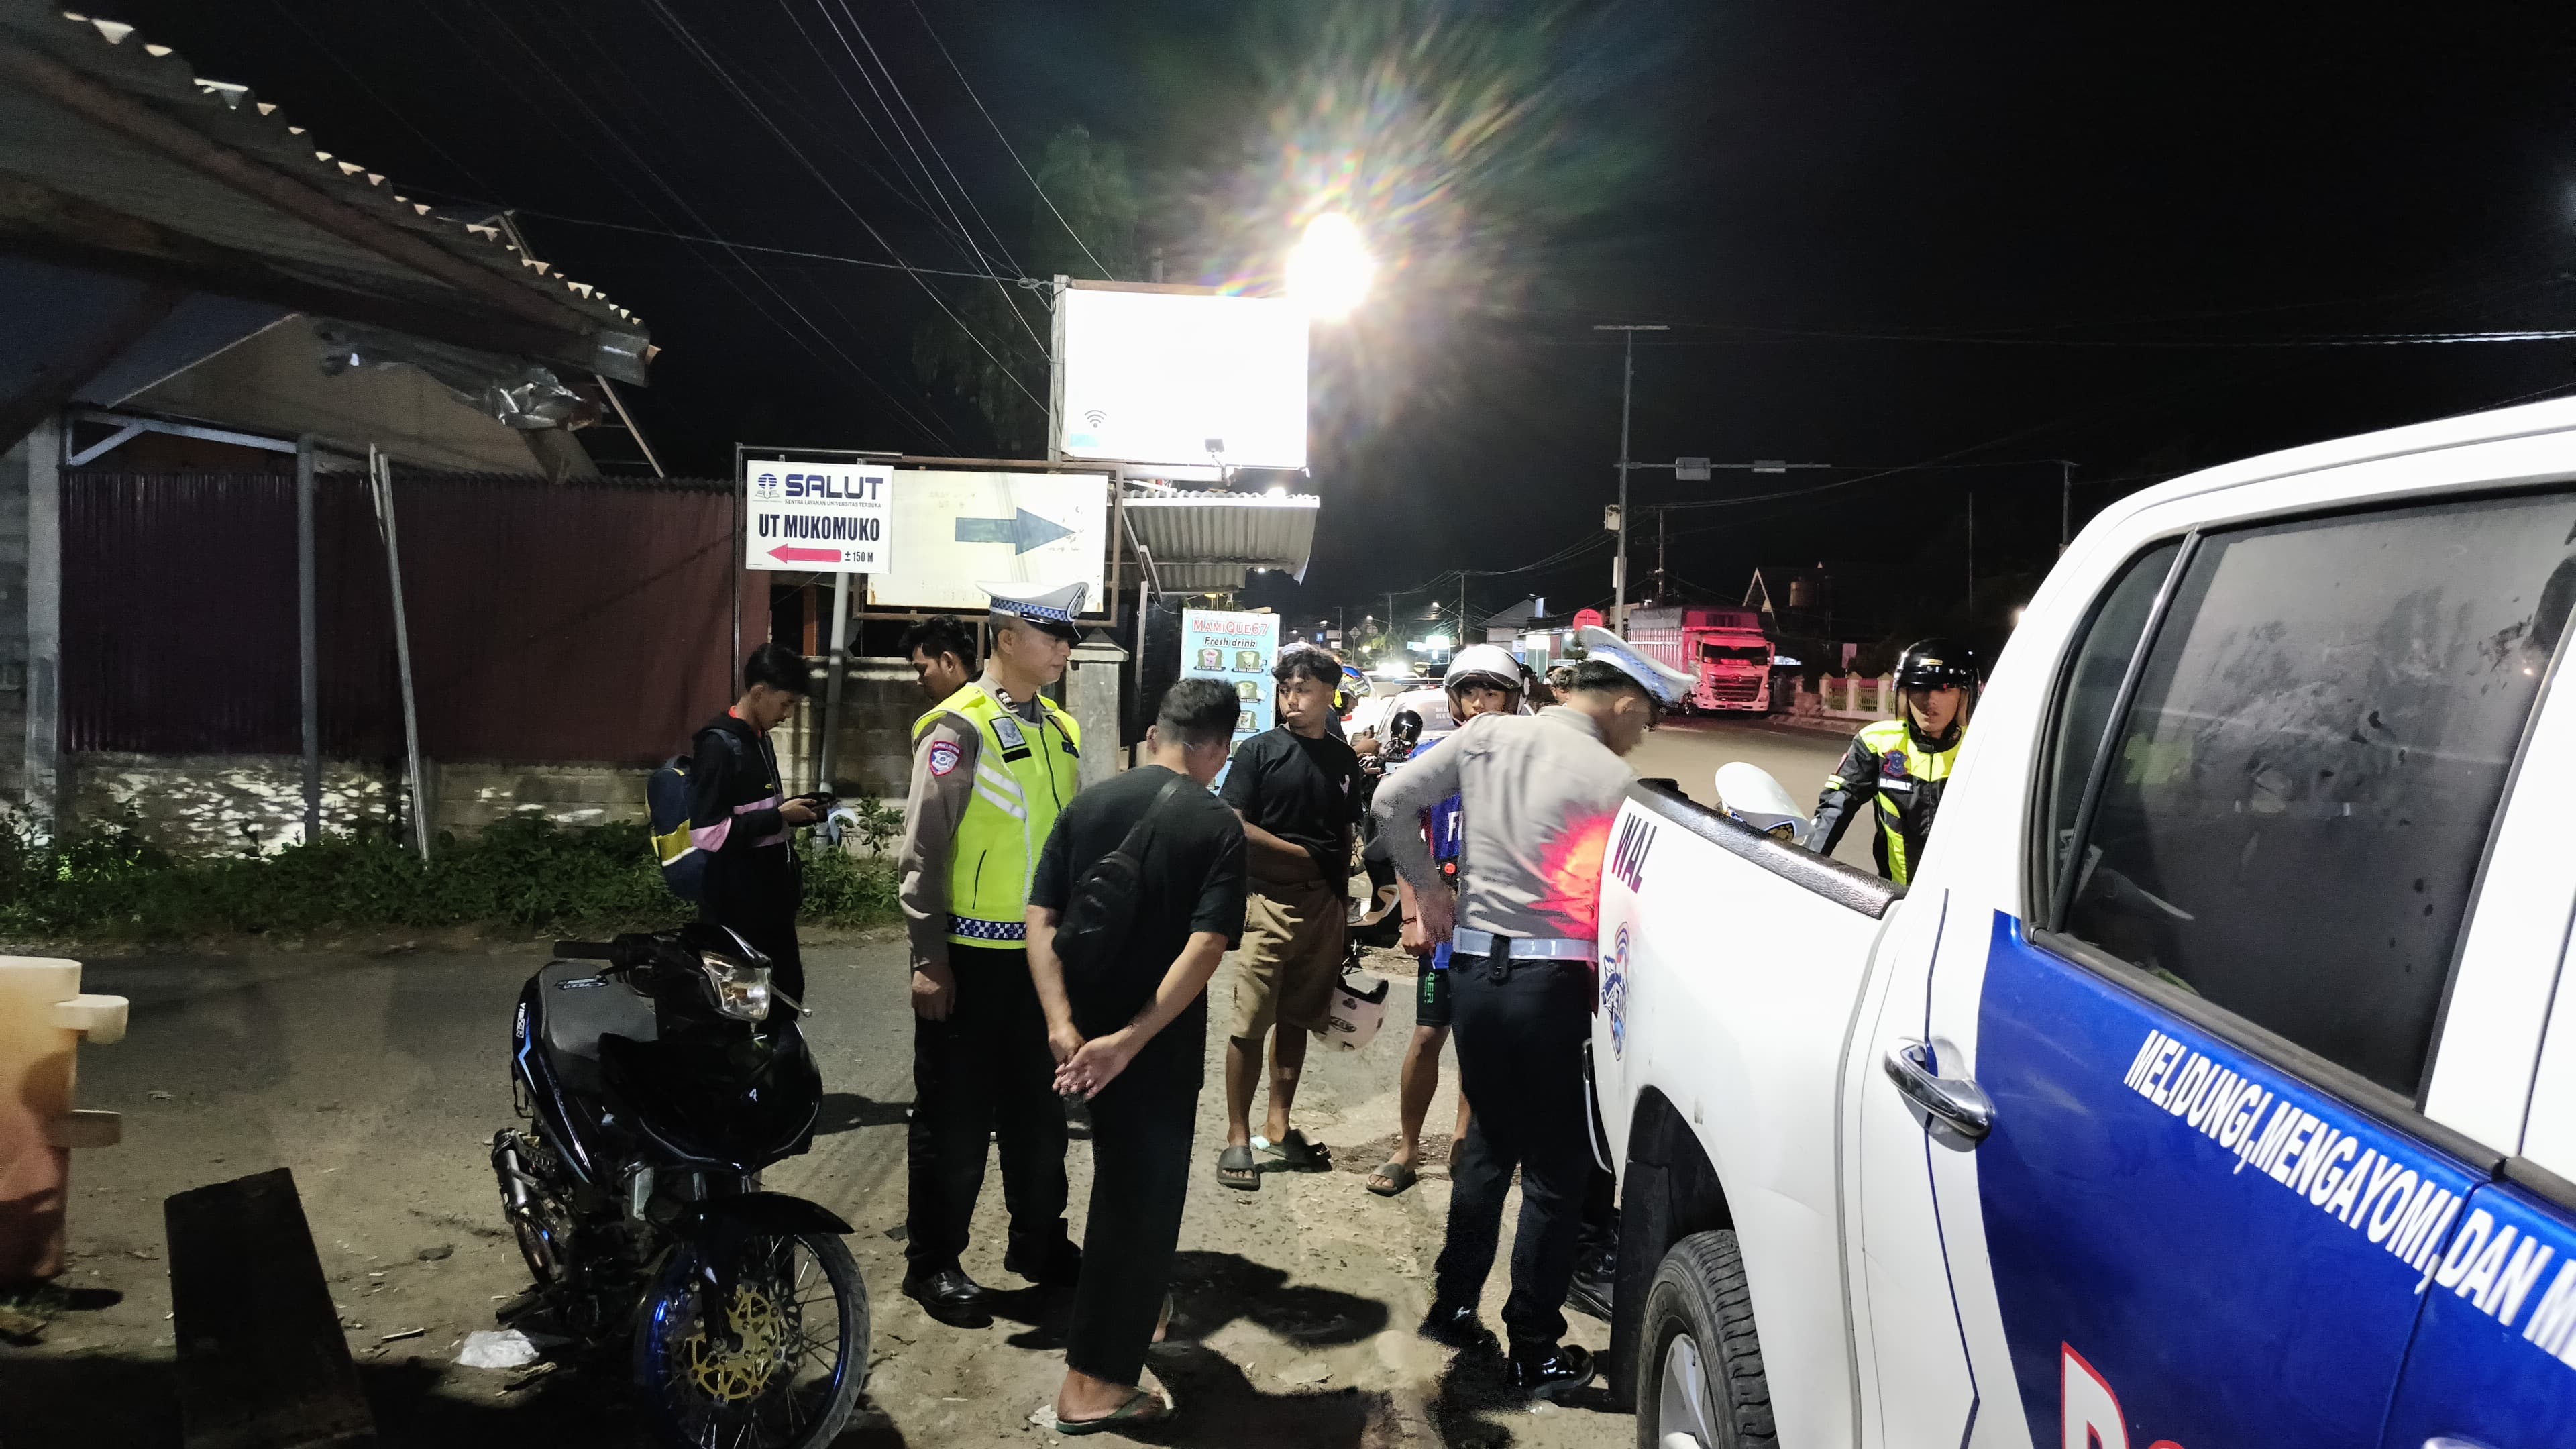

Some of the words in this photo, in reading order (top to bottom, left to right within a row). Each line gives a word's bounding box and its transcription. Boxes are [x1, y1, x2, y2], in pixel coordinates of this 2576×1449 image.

[785, 474, 883, 500] SALUT
[759, 514, 780, 537] UT
[784, 515, 880, 541] MUKOMUKO
[853, 551, 865, 562] 150
[867, 552, 873, 562] M
[1204, 636, 1229, 647] Fresh
[1231, 638, 1257, 648] drink
[1611, 812, 1657, 894] WAL
[2434, 1208, 2555, 1327] DAN
